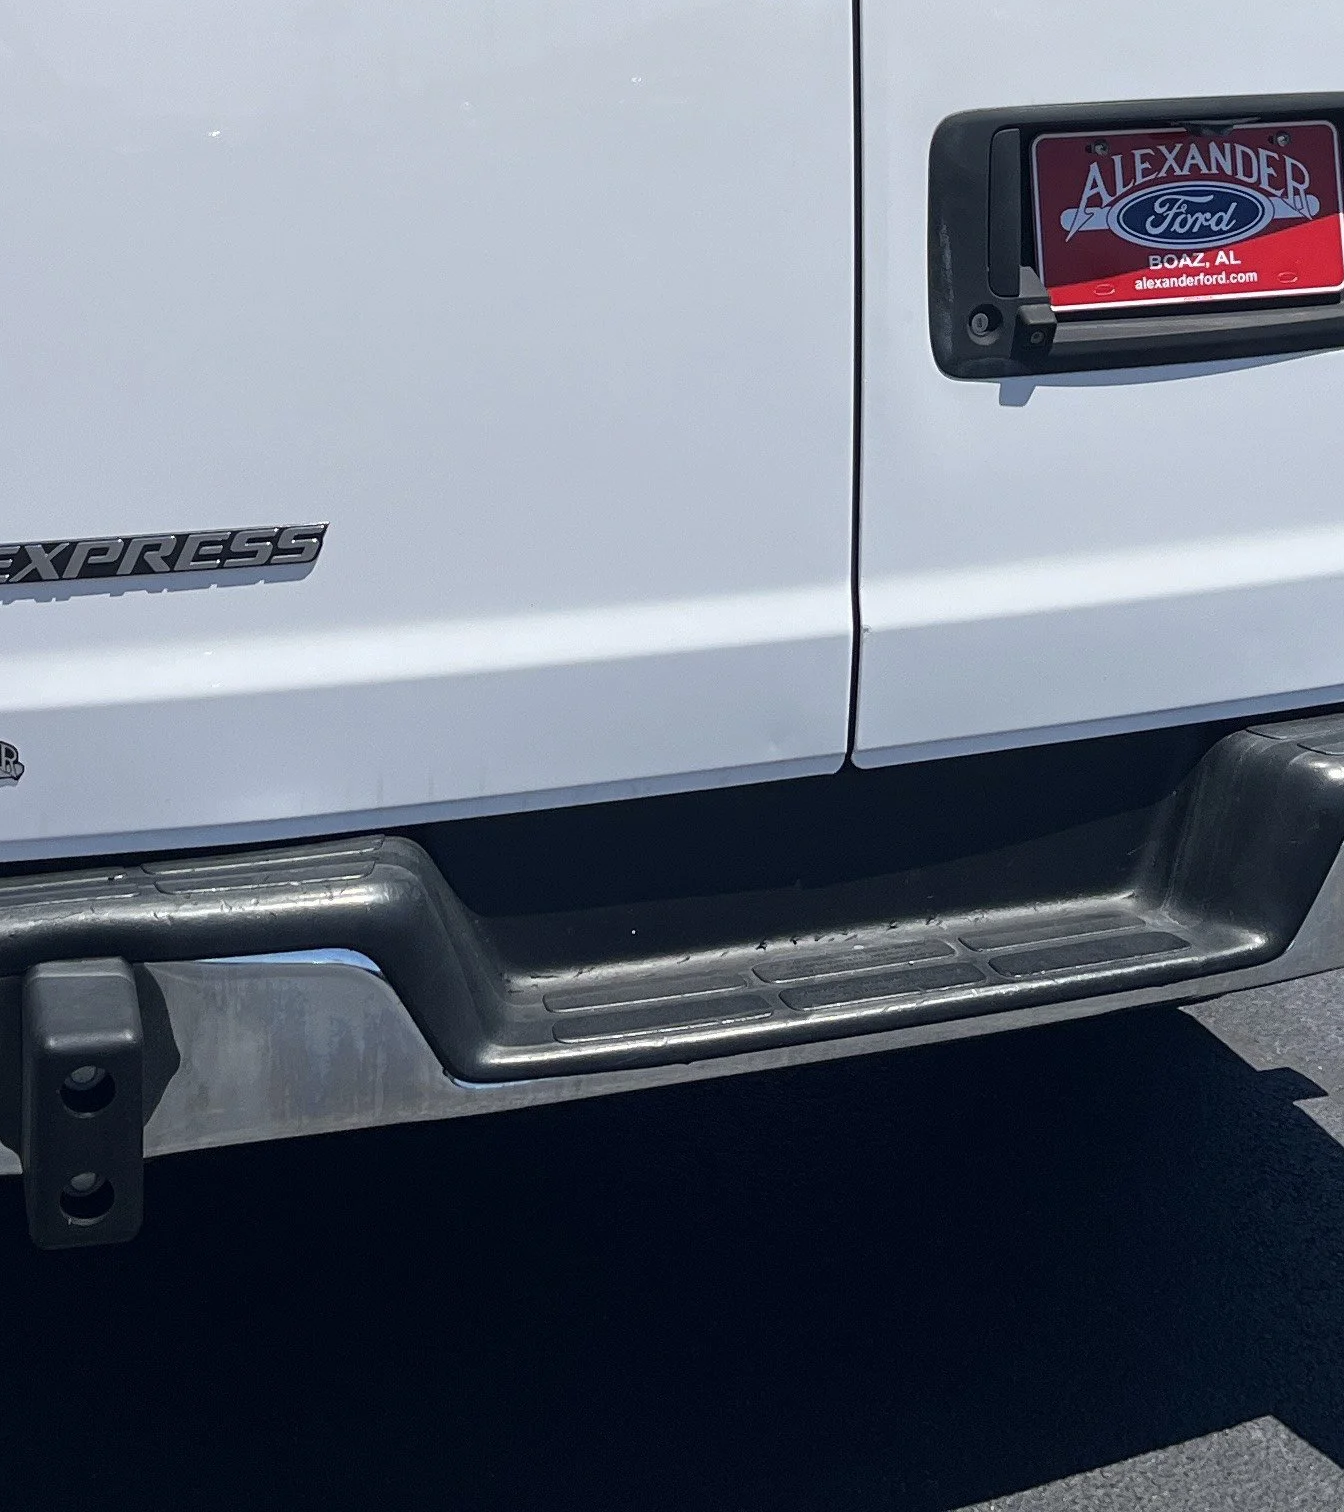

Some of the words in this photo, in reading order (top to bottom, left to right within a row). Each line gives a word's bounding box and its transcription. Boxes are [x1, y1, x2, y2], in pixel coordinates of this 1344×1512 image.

[1065, 141, 1314, 242] ALEXANDER
[1145, 193, 1237, 235] Ford
[1148, 252, 1210, 270] BOAZ,
[1214, 250, 1242, 266] AL
[1135, 271, 1258, 290] alexanderford.com
